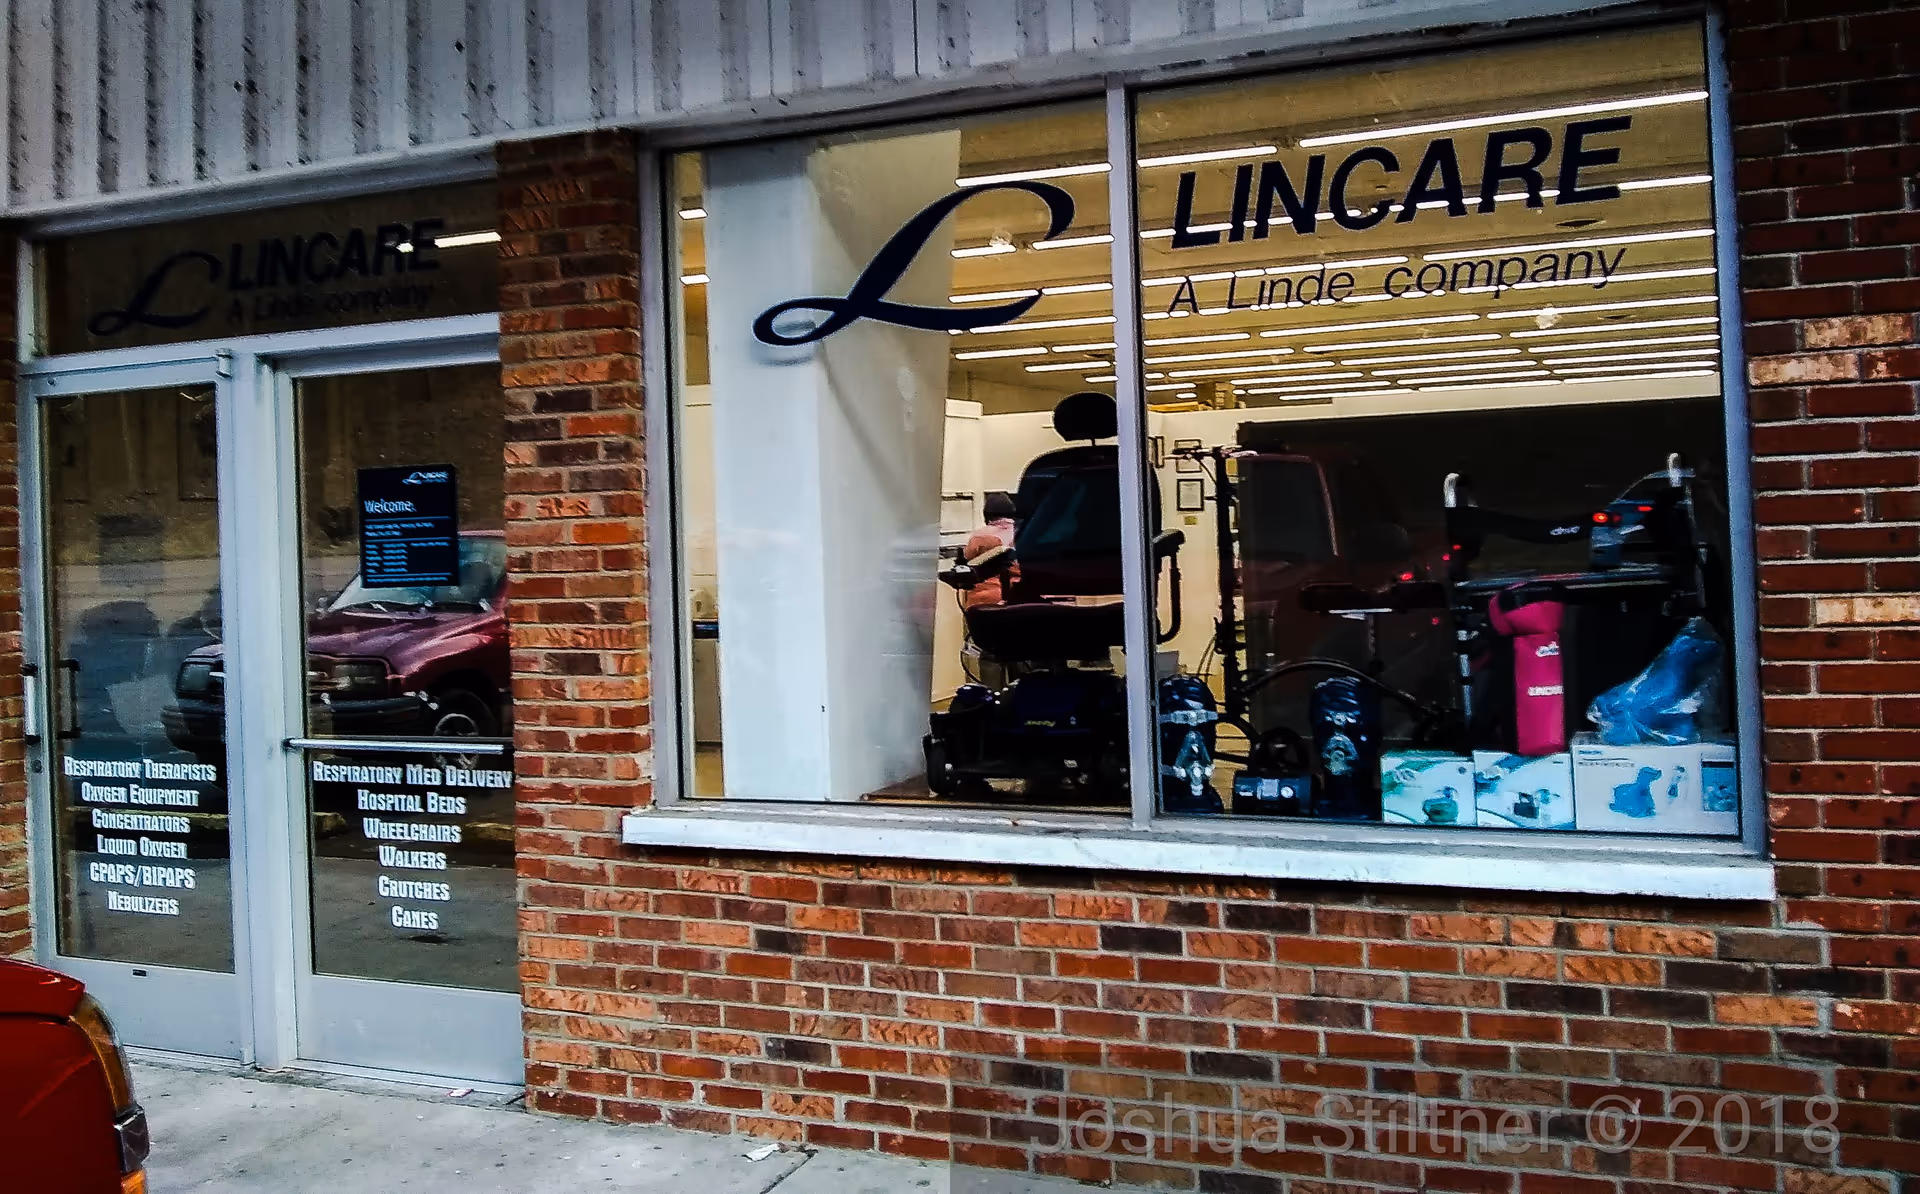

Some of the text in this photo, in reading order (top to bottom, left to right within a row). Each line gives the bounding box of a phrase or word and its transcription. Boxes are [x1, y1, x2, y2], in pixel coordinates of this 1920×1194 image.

[1171, 115, 1632, 250] LINCARE
[227, 219, 444, 291] LINCARE
[1168, 247, 1628, 314] A Linde company
[63, 755, 217, 782] RESPIRATORY THERAPISTS
[312, 761, 403, 784] RESPIRATORY
[445, 765, 513, 789] DELIVERY
[357, 789, 467, 815] HOSPITAL BEDS
[91, 808, 191, 834] CONCENTRATORS
[362, 817, 462, 843] WHEELCHAIRS
[96, 833, 138, 856] LIQUID
[378, 845, 448, 870] WALKERS
[89, 861, 197, 890] CPAPS/BIPAPS
[378, 875, 451, 901] CRUTCHES
[106, 890, 181, 916] NEBULIZERS
[391, 905, 440, 931] CANES
